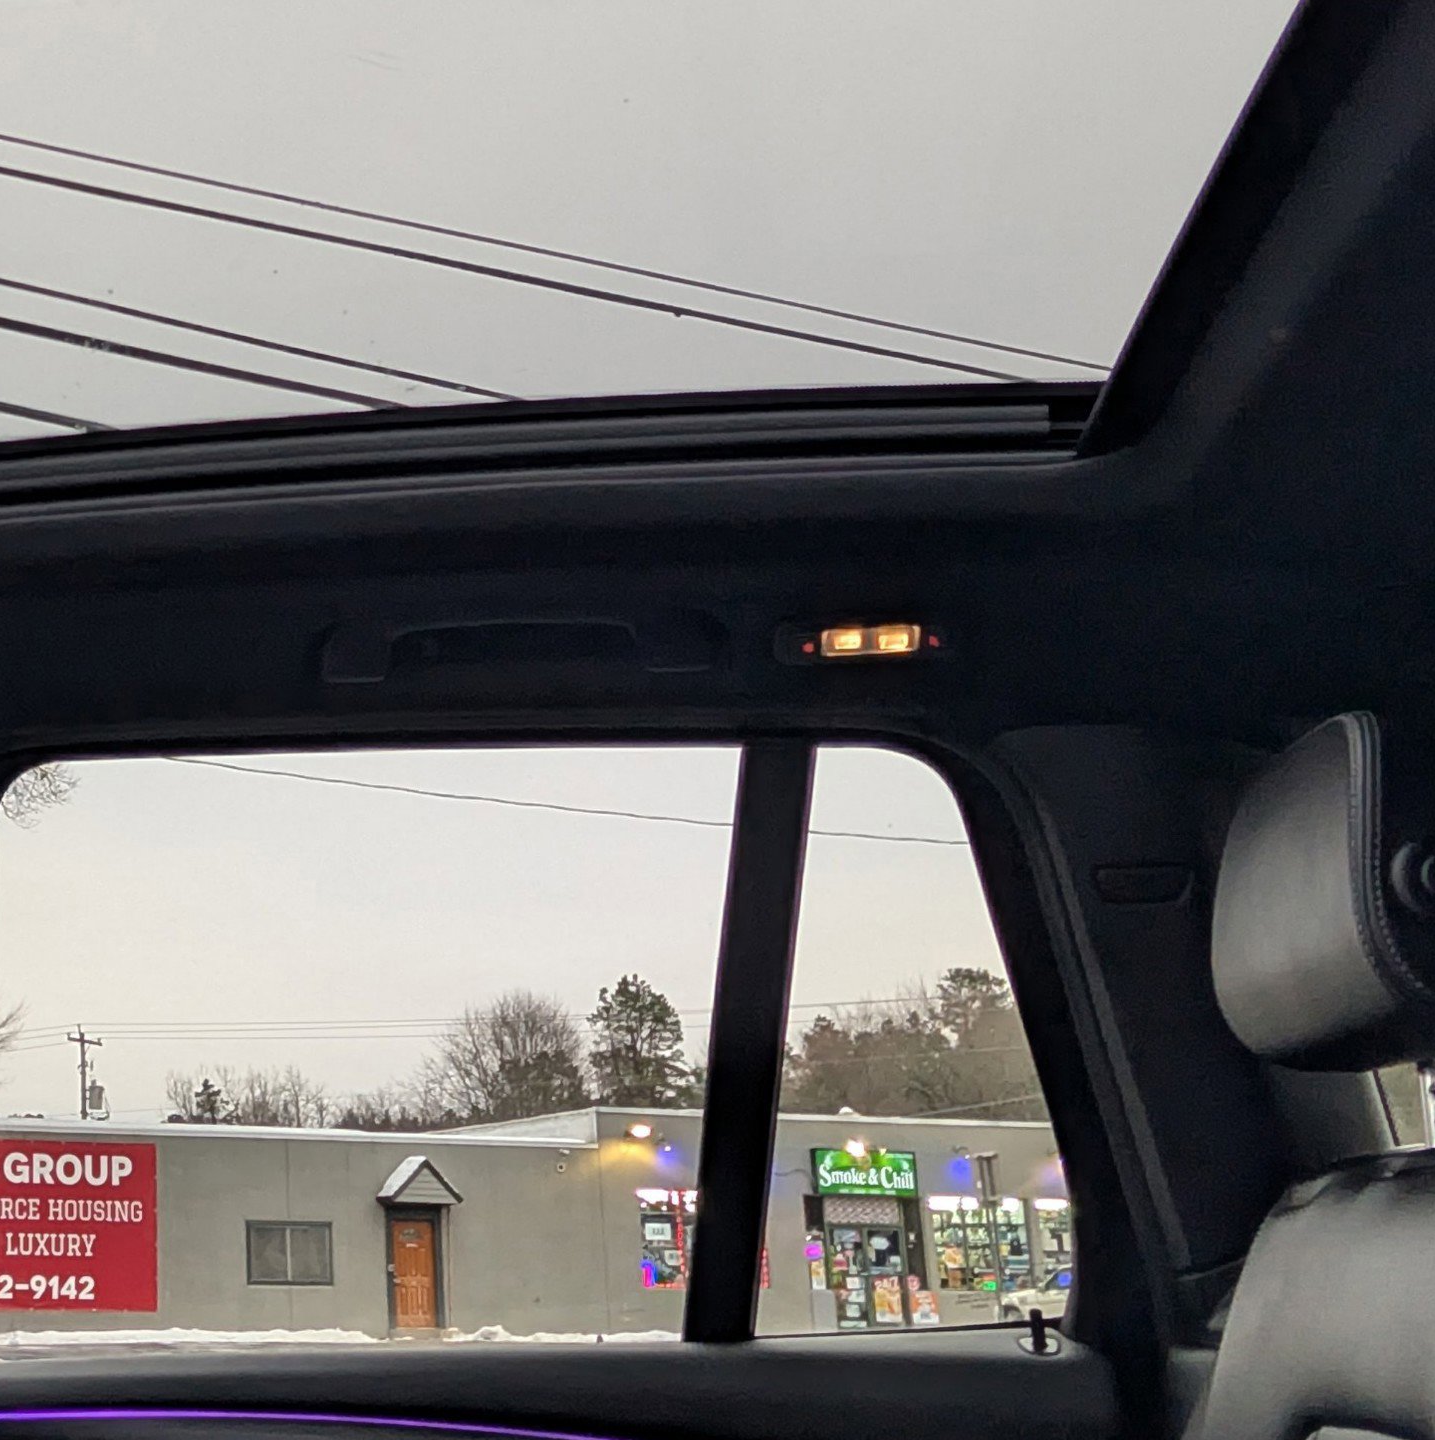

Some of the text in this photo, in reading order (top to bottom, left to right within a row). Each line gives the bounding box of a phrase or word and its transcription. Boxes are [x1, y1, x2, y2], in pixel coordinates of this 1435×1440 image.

[3, 1152, 133, 1187] GROUP
[819, 1163, 915, 1190] Smoke & Chill
[48, 1199, 143, 1223] HOUSING
[5, 1233, 97, 1257] LUXURY
